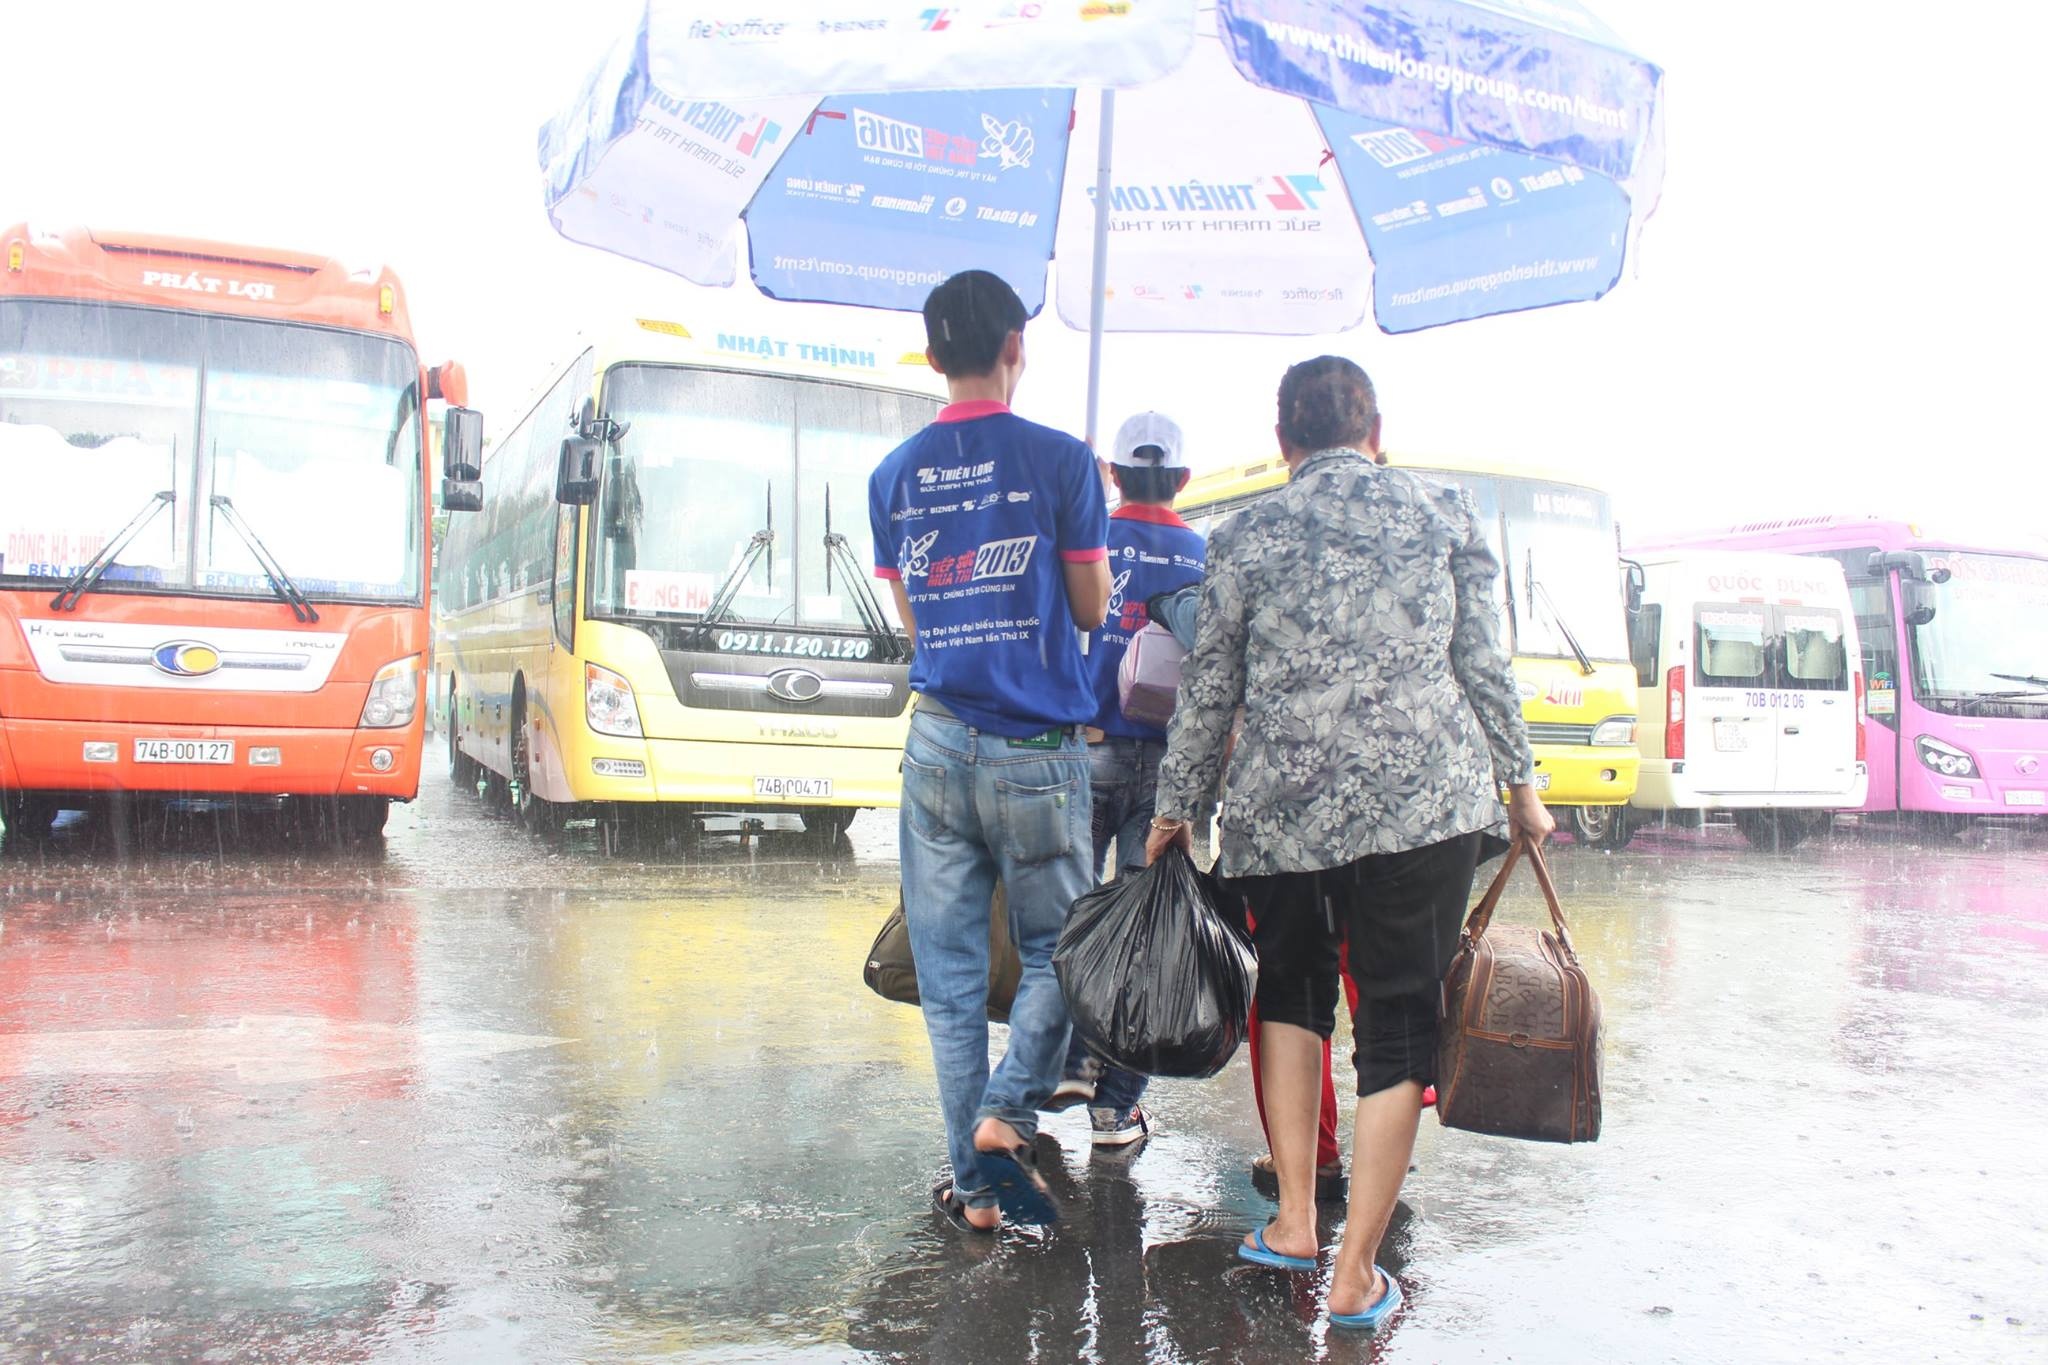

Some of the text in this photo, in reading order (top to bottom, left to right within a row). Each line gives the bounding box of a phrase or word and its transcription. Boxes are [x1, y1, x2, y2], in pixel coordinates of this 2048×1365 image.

[1263, 19, 1629, 130] www.thienlonggroup.com/tsmt
[143, 269, 277, 300] PHÁT LỢI
[717, 333, 875, 368] NHẬT THỊNH
[940, 461, 995, 482] THIÊN LONG
[975, 540, 1032, 575] 2013
[933, 624, 947, 636] Đại
[962, 622, 975, 633] đại
[1015, 616, 1040, 628] quốc
[965, 636, 984, 645] Nam
[1019, 631, 1030, 640] IX
[718, 632, 870, 659] 0911.120.120
[138, 740, 230, 762] 74B-001.27
